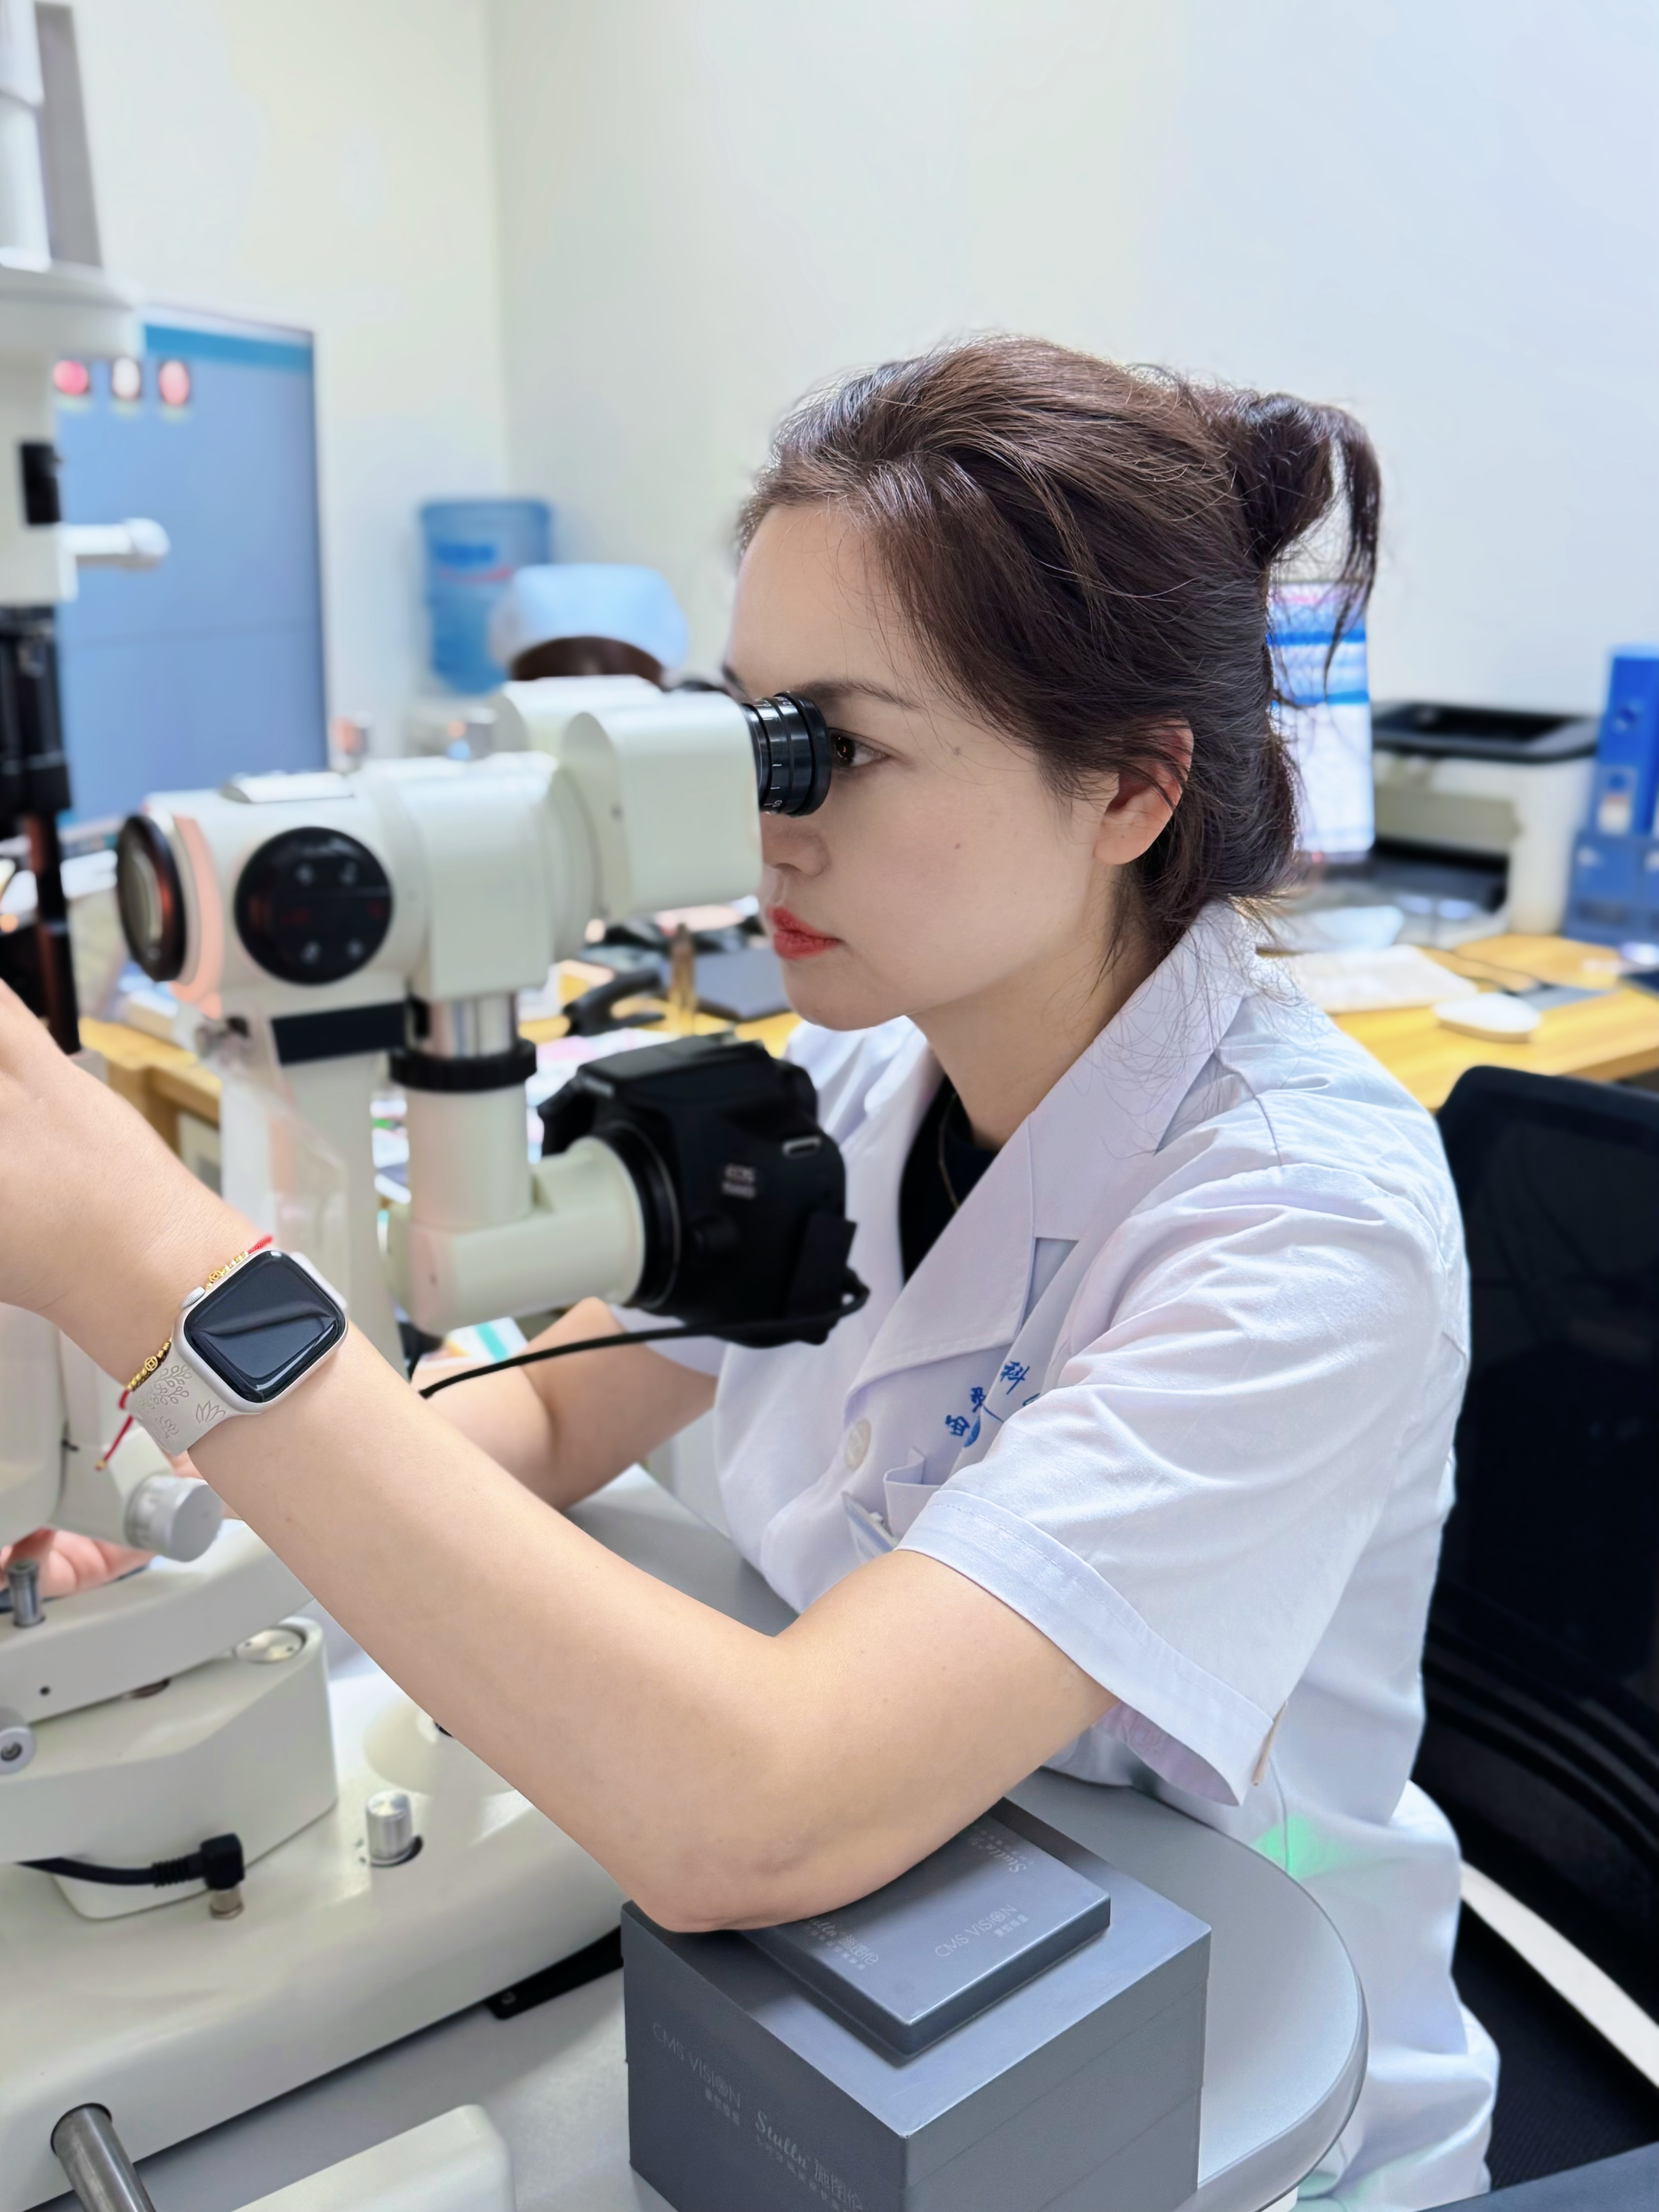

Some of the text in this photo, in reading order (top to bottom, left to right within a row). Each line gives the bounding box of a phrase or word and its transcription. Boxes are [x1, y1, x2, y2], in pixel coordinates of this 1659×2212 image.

[935, 1934, 969, 1956] CMS
[965, 1903, 1017, 1936] VISION
[653, 2022, 684, 2060] CMS
